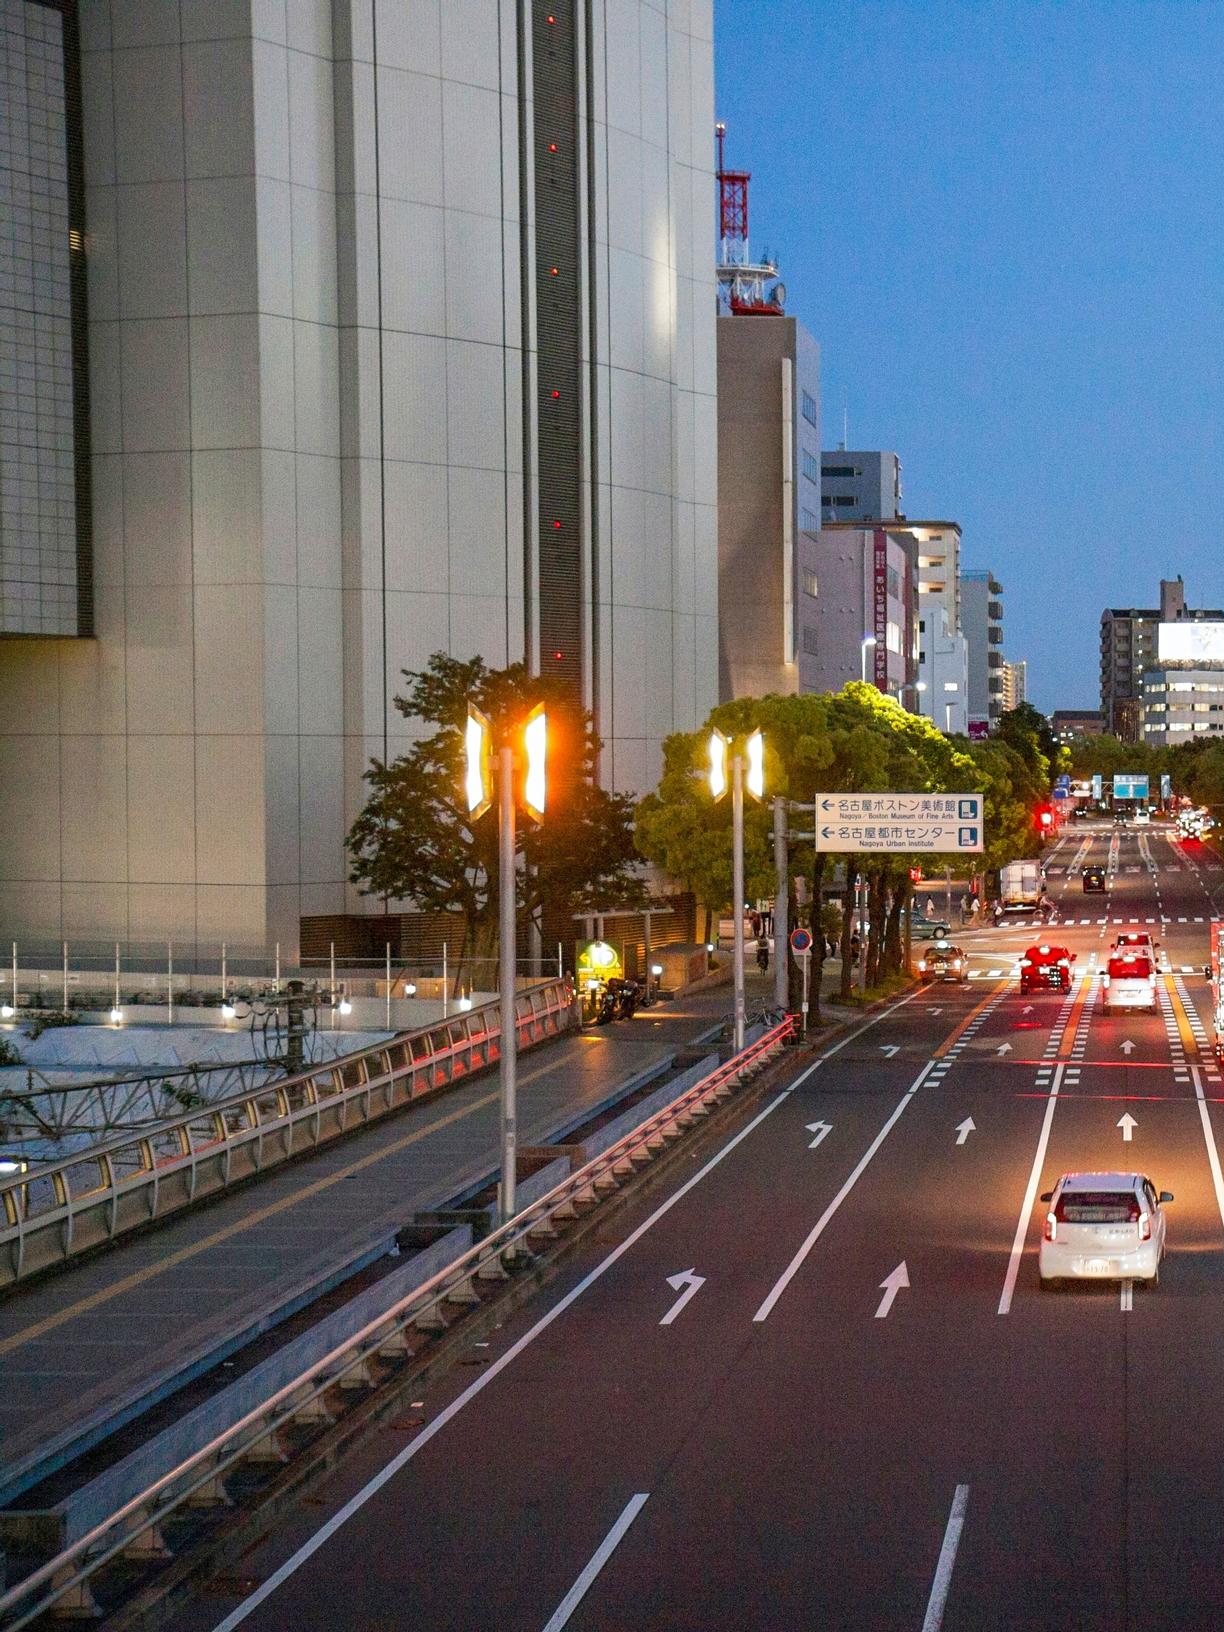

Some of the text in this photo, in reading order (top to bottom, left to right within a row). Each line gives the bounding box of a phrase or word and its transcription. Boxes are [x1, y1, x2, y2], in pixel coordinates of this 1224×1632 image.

[838, 799, 956, 811] 名古屋ボストン美術館
[838, 827, 955, 838] 名古屋都市センター
